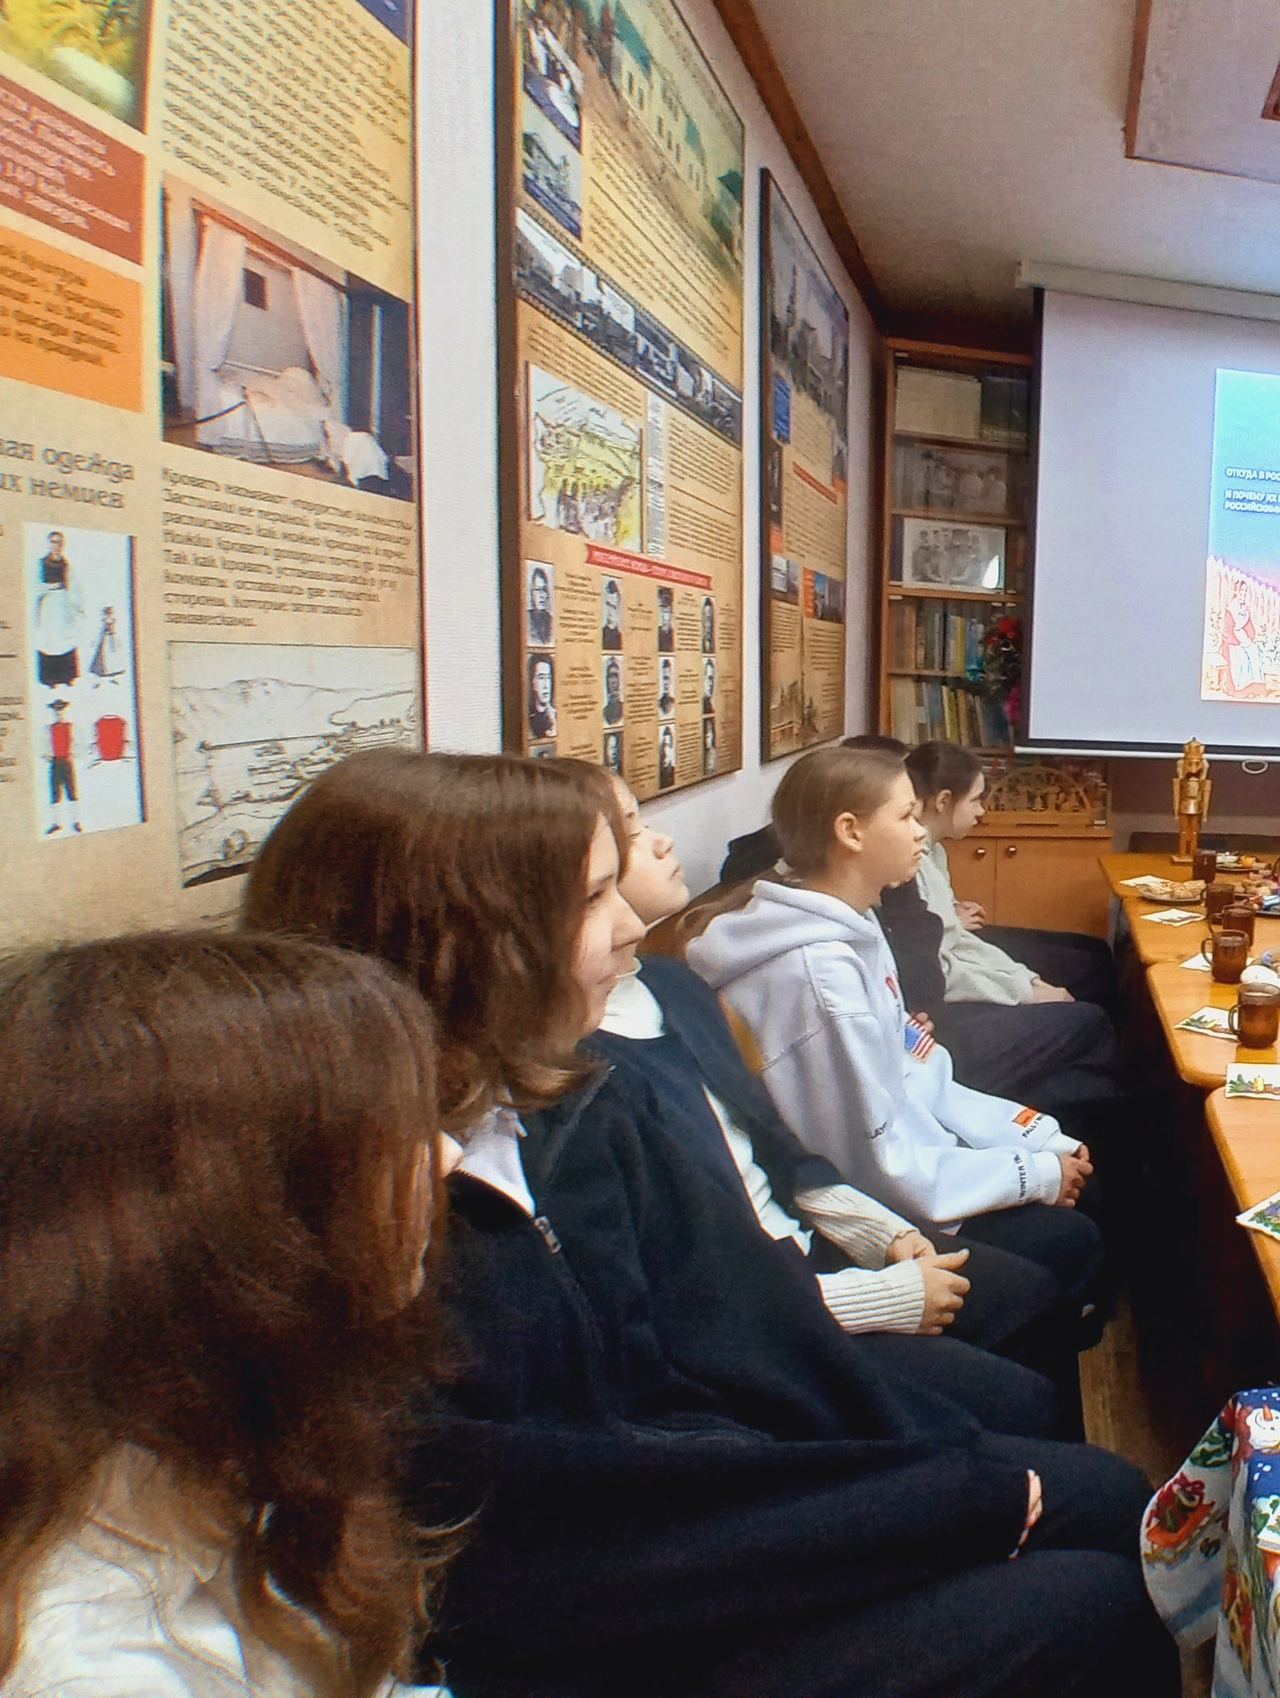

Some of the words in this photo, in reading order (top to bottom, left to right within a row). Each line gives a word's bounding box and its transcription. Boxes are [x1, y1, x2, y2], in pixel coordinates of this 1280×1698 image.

[41, 448, 135, 484] одежда
[1226, 468, 1257, 479] ОТКУДА
[1259, 470, 1265, 479] В
[29, 477, 124, 509] немцев
[1225, 489, 1231, 499] И
[1233, 490, 1265, 501] ПОЧЕМУ
[1266, 493, 1277, 502] ИХ
[1018, 1165, 1027, 1199] WINTER
